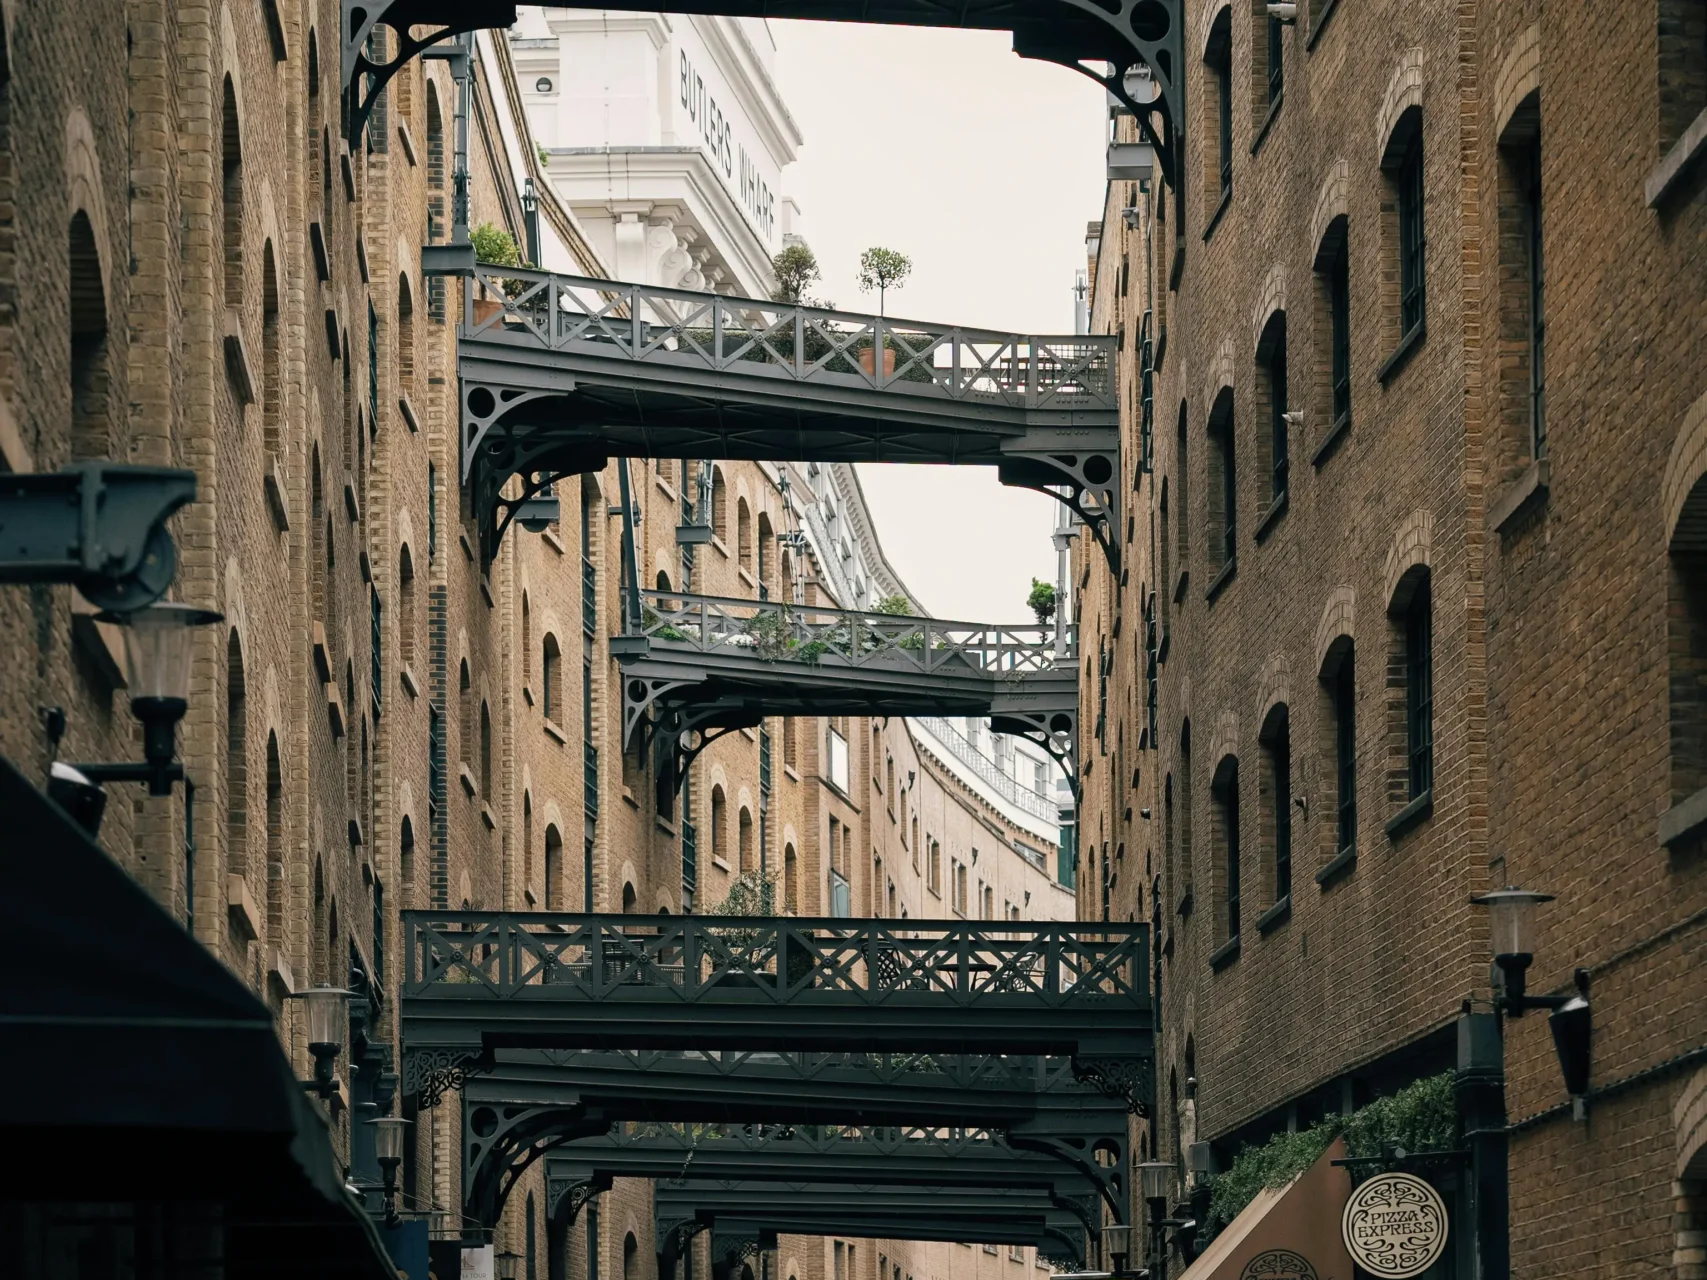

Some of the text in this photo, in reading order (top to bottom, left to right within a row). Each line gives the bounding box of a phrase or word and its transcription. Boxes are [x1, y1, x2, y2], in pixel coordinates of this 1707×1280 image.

[680, 47, 775, 243] BUTLERS WHARF
[1371, 1210, 1419, 1224] PIZZA
[1357, 1221, 1435, 1238] EXPRESS
